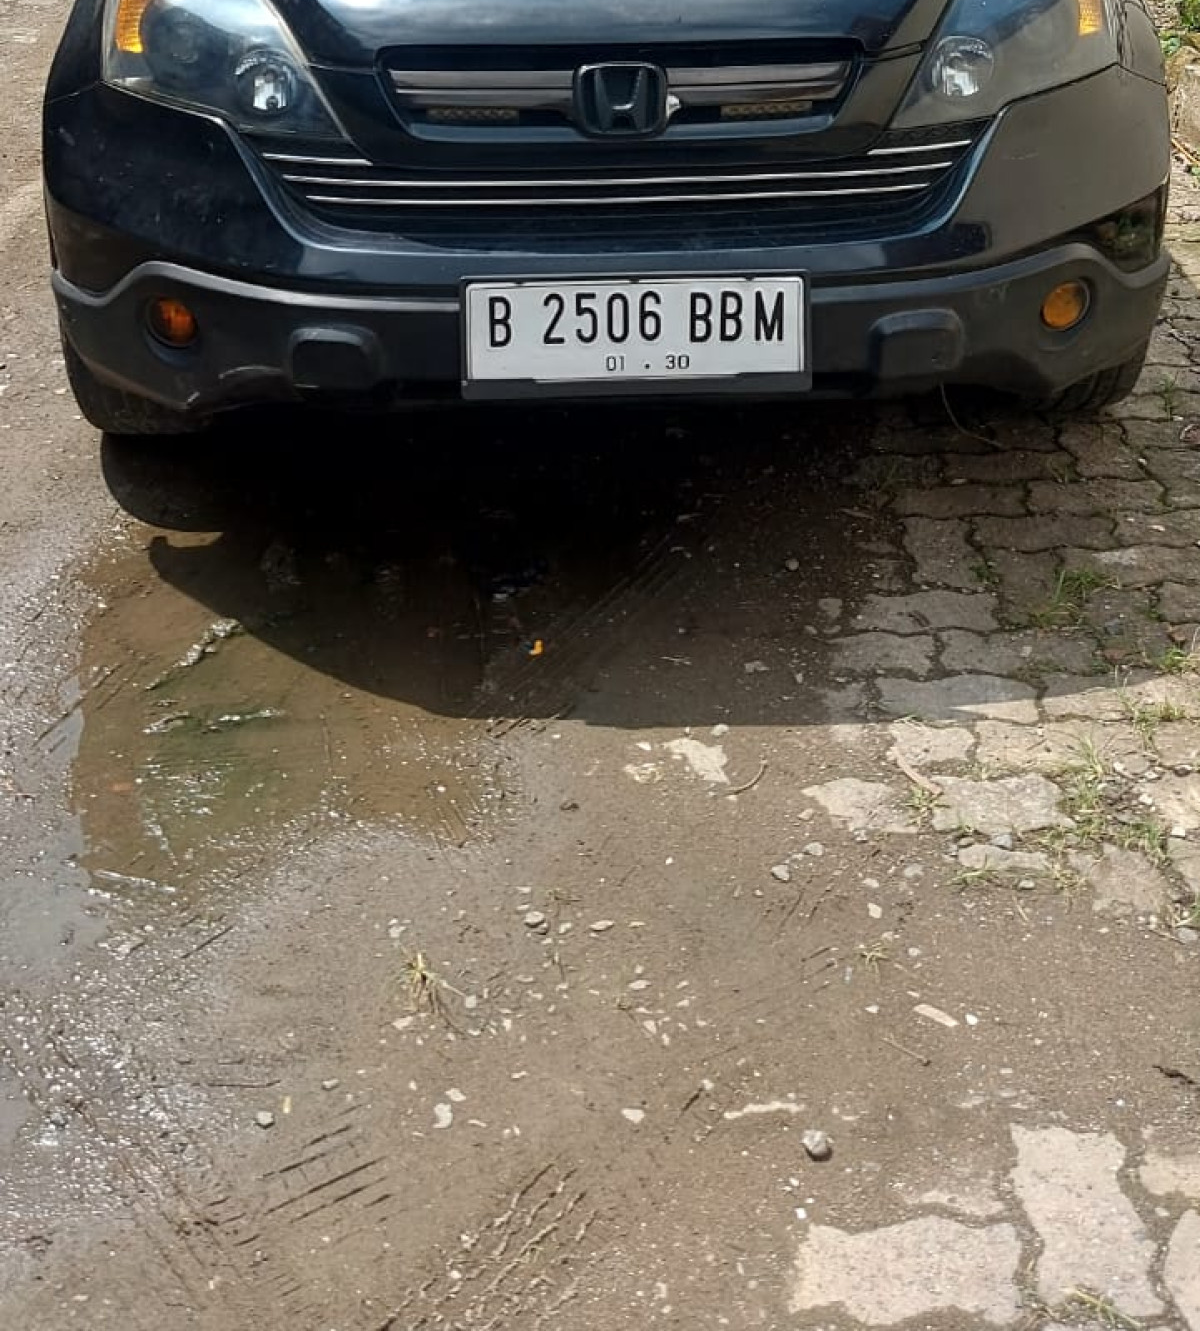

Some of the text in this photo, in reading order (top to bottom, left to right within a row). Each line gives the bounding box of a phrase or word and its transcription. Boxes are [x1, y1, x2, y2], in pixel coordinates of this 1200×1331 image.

[488, 290, 785, 348] B 2506 BBM
[605, 355, 625, 372] 01
[665, 354, 690, 370] 30
